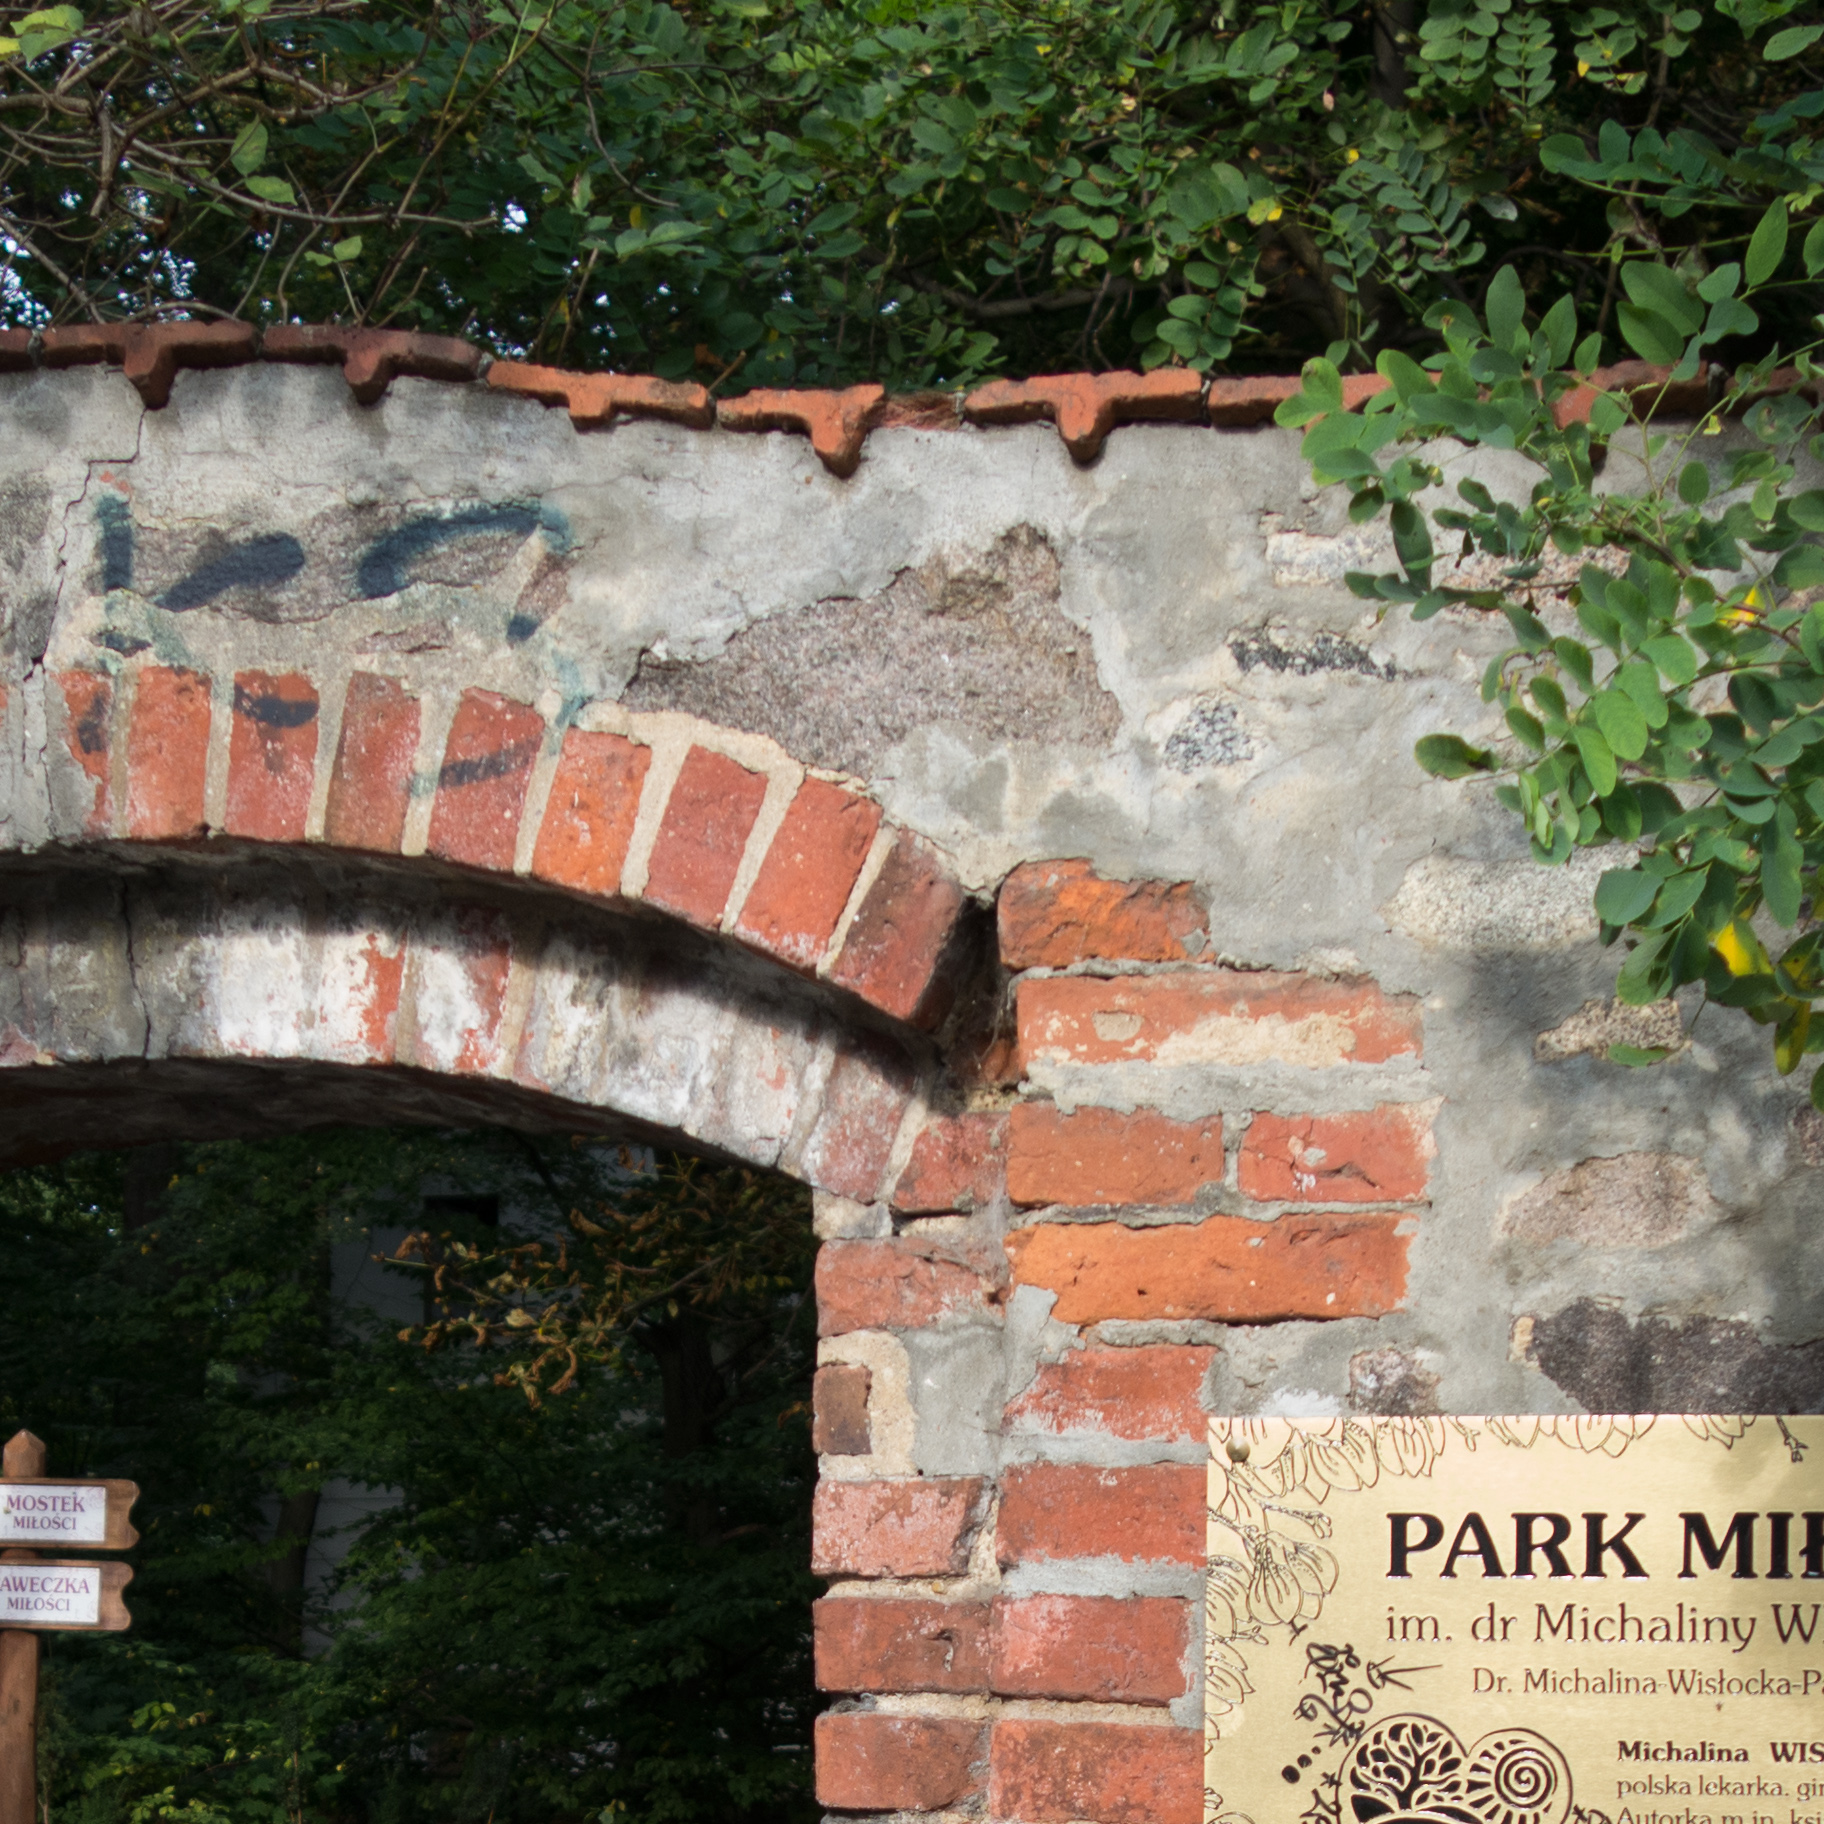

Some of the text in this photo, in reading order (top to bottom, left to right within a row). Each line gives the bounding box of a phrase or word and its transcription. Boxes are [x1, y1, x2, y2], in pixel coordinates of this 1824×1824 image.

[6, 1494, 86, 1513] MOSTEK
[13, 1513, 77, 1531] MIŁOŚCI
[1386, 1512, 1649, 1578] PARK
[6, 1594, 71, 1612] MIŁOŚCI
[1387, 1606, 1452, 1641] im.
[1471, 1602, 1516, 1641] dr
[1534, 1602, 1756, 1653] Michaliny
[1473, 1668, 1511, 1693] Dr.
[1618, 1741, 1748, 1762] Michalina
